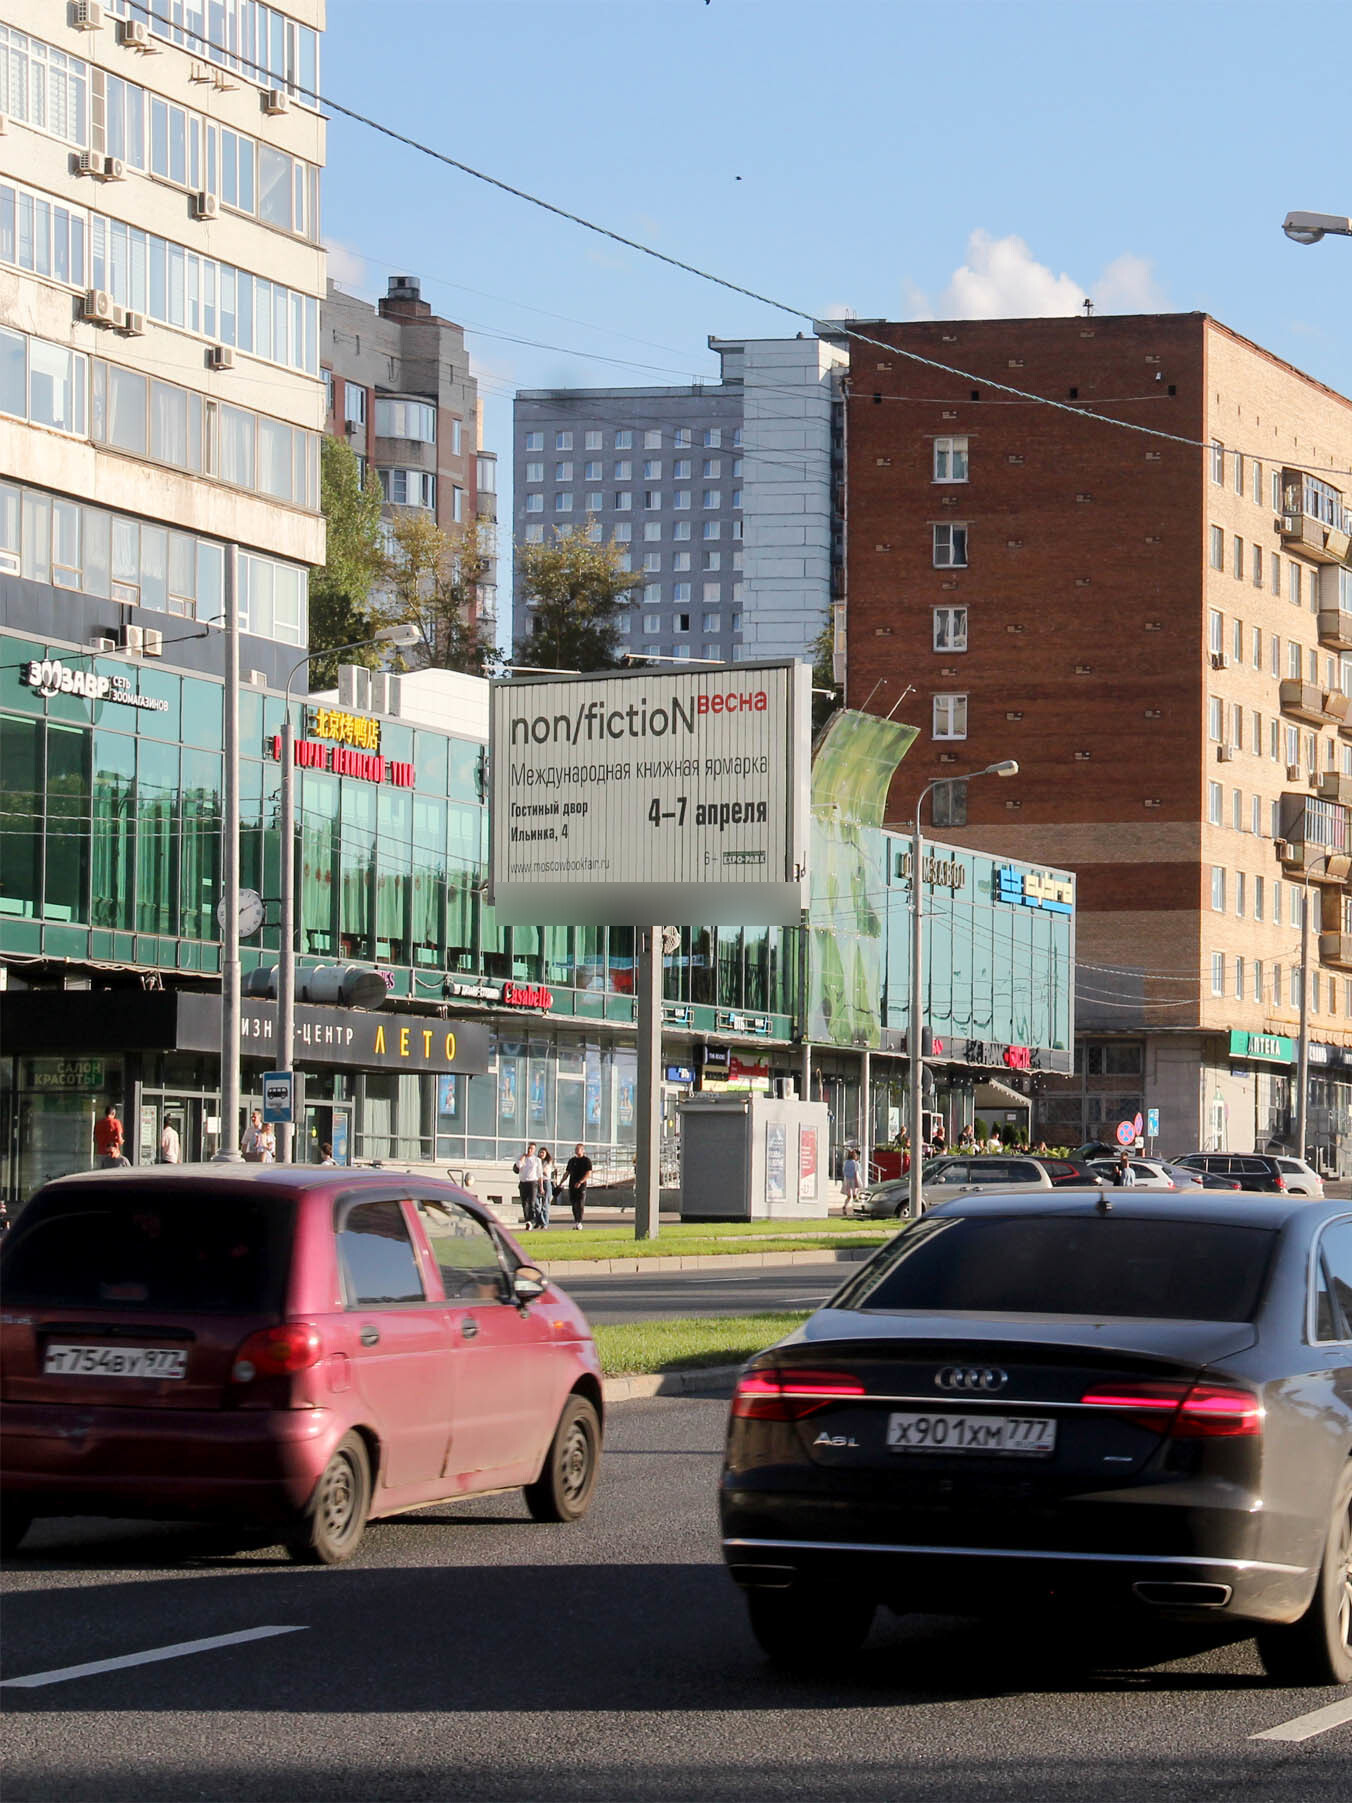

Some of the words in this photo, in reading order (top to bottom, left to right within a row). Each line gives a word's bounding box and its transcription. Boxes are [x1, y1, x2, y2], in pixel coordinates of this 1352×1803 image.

[112, 675, 131, 689] СЕТЬ
[112, 690, 169, 711] ЗООМАГАЗИНОВ
[511, 695, 695, 746] non/fictioN
[697, 690, 768, 715] весна
[511, 761, 631, 790] Международная
[636, 758, 699, 779] книжная
[704, 754, 768, 780] ярмарка
[510, 800, 560, 818] Гостиный
[562, 800, 588, 817] двор
[695, 800, 768, 832] апреля
[510, 824, 558, 843] Ильинка,
[561, 823, 569, 840] 4
[510, 857, 610, 874] www.moscowbookfair.ru
[375, 1024, 456, 1061] ЛЕТО
[1248, 1036, 1281, 1057] АПТЕКА
[57, 1062, 101, 1074] САЛОН
[34, 1073, 96, 1085] КРАСОТЫ
